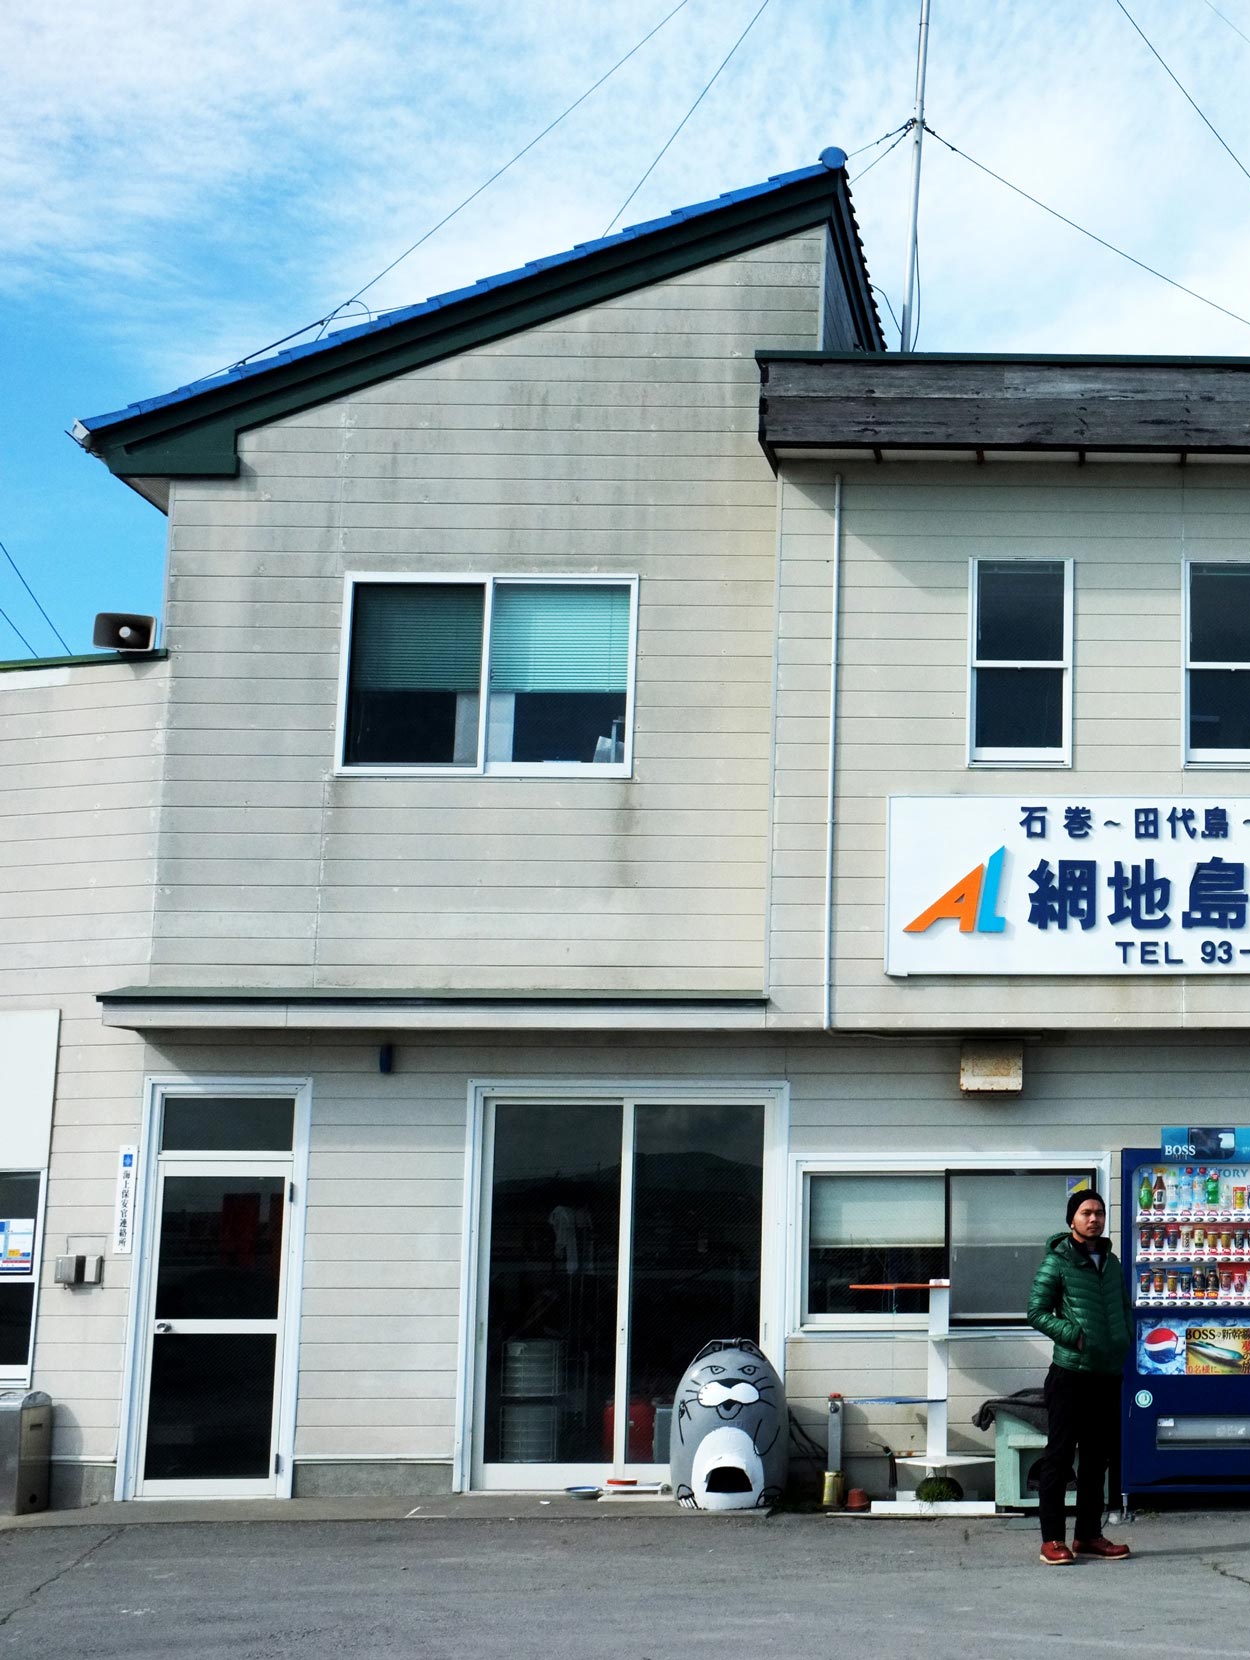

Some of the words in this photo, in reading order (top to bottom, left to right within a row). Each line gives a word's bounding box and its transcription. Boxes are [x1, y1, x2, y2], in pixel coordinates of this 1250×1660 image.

[1115, 941, 1184, 965] TEL
[1164, 1145, 1196, 1156] BOSS
[1217, 1168, 1249, 1178] TORY
